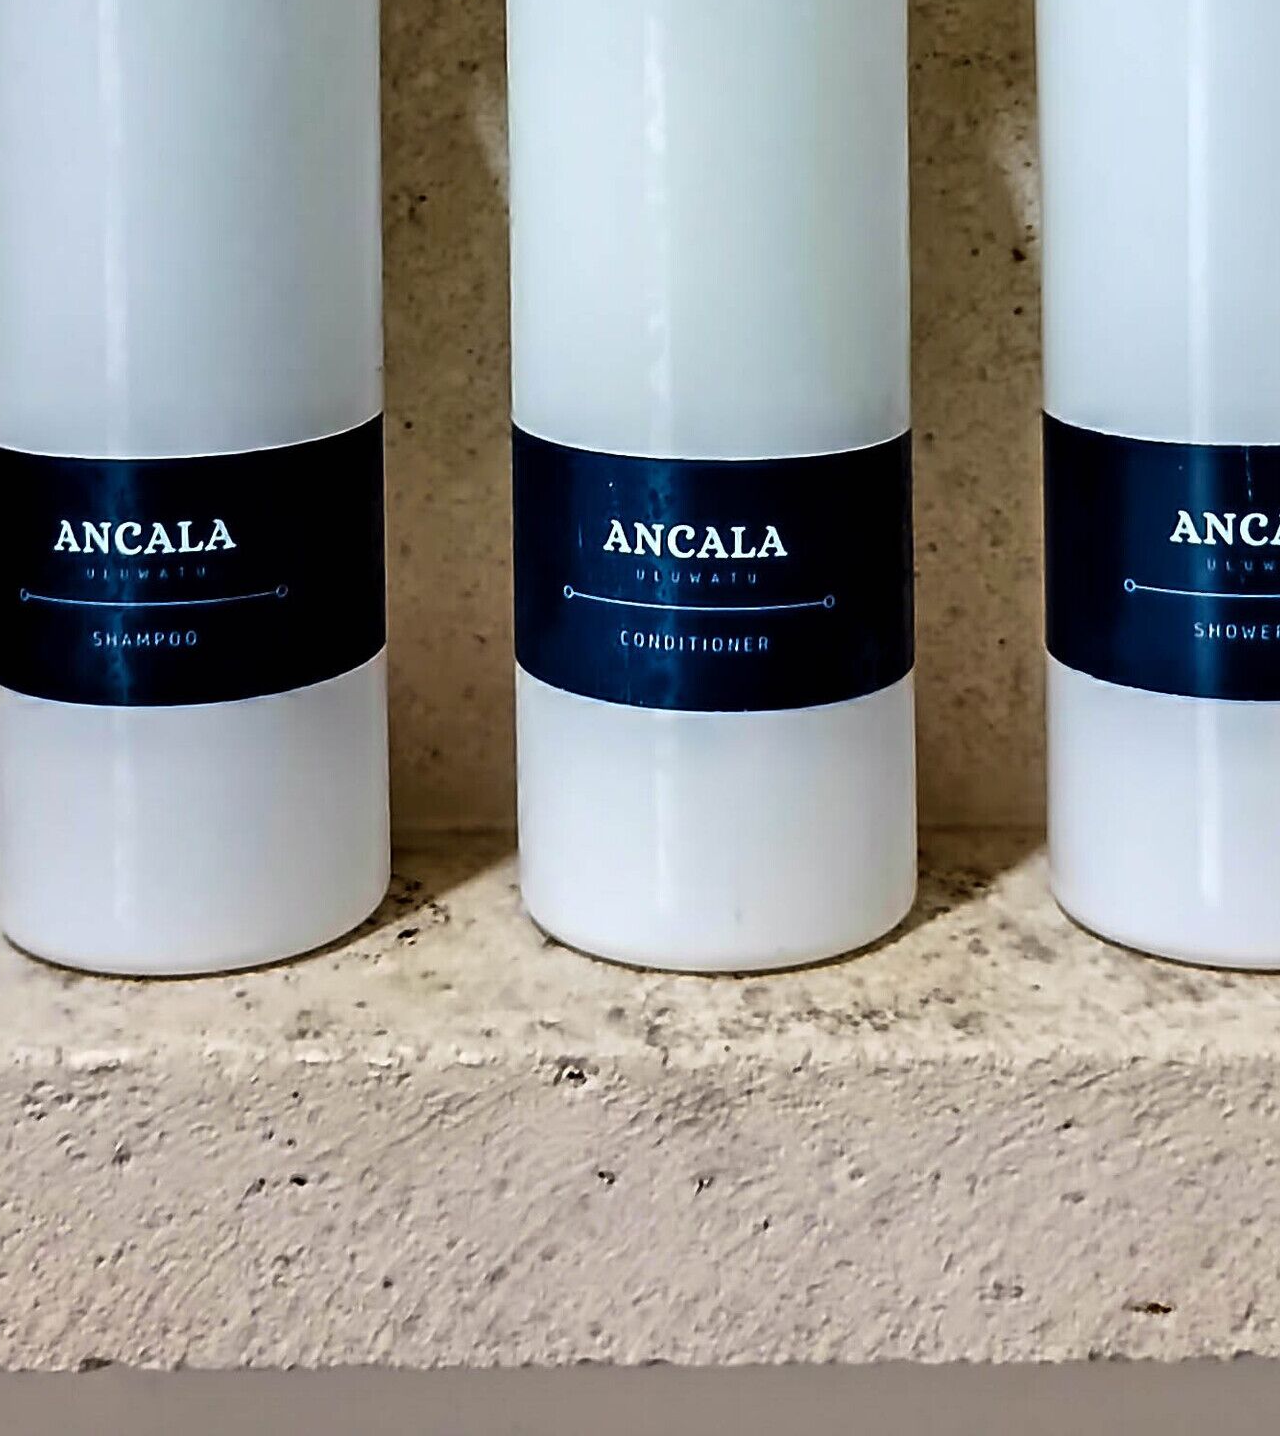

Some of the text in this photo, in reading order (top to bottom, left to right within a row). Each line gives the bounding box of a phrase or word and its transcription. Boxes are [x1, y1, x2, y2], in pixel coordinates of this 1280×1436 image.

[54, 519, 237, 556] ANCALA
[603, 519, 788, 559] ANCALA
[636, 568, 756, 584] ULUWATU
[92, 630, 198, 647] SHAMPOO
[620, 630, 769, 652] CONDITIONER
